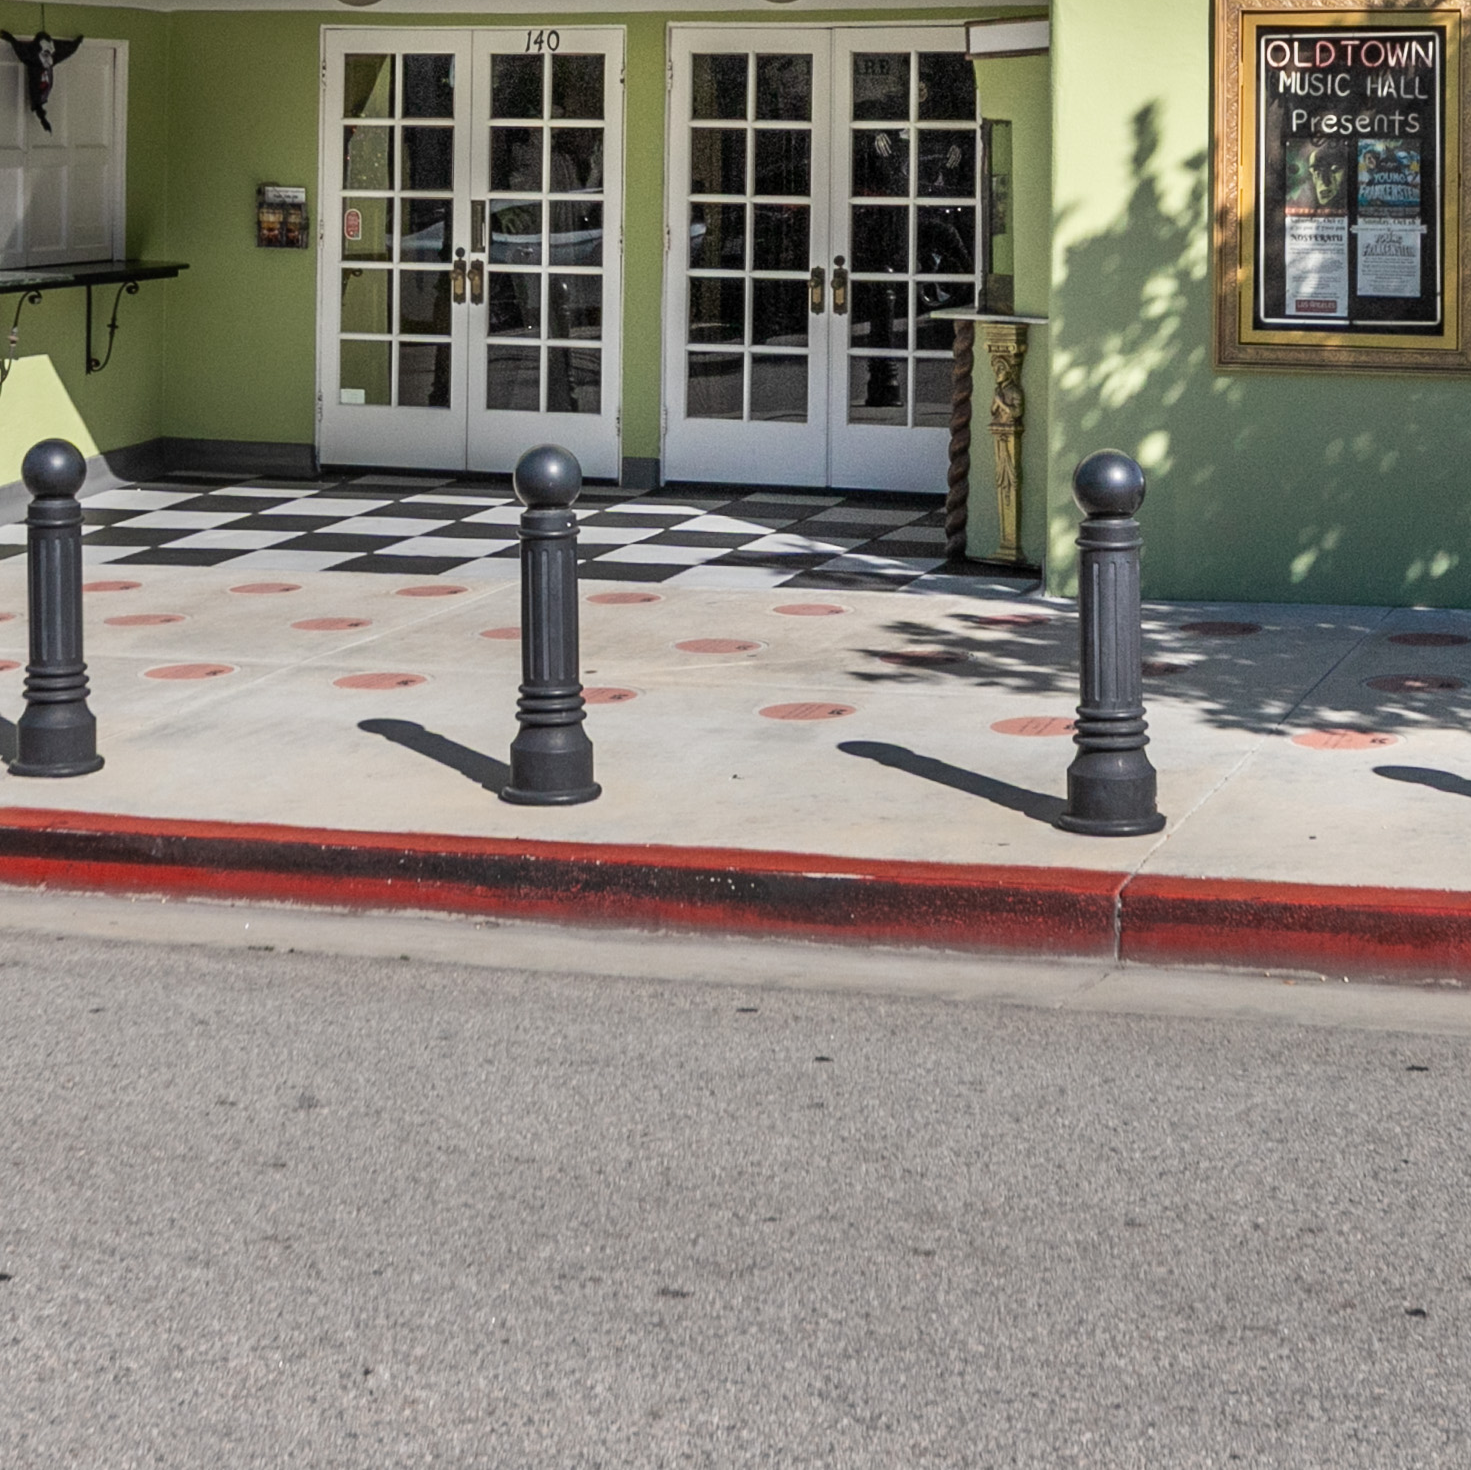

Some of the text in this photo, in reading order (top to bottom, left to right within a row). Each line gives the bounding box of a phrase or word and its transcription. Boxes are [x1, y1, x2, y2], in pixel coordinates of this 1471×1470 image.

[525, 30, 560, 52] 140
[1278, 70, 1428, 99] MUSIC HALL
[1292, 109, 1420, 136] Presents
[1373, 171, 1407, 183] YOUNG
